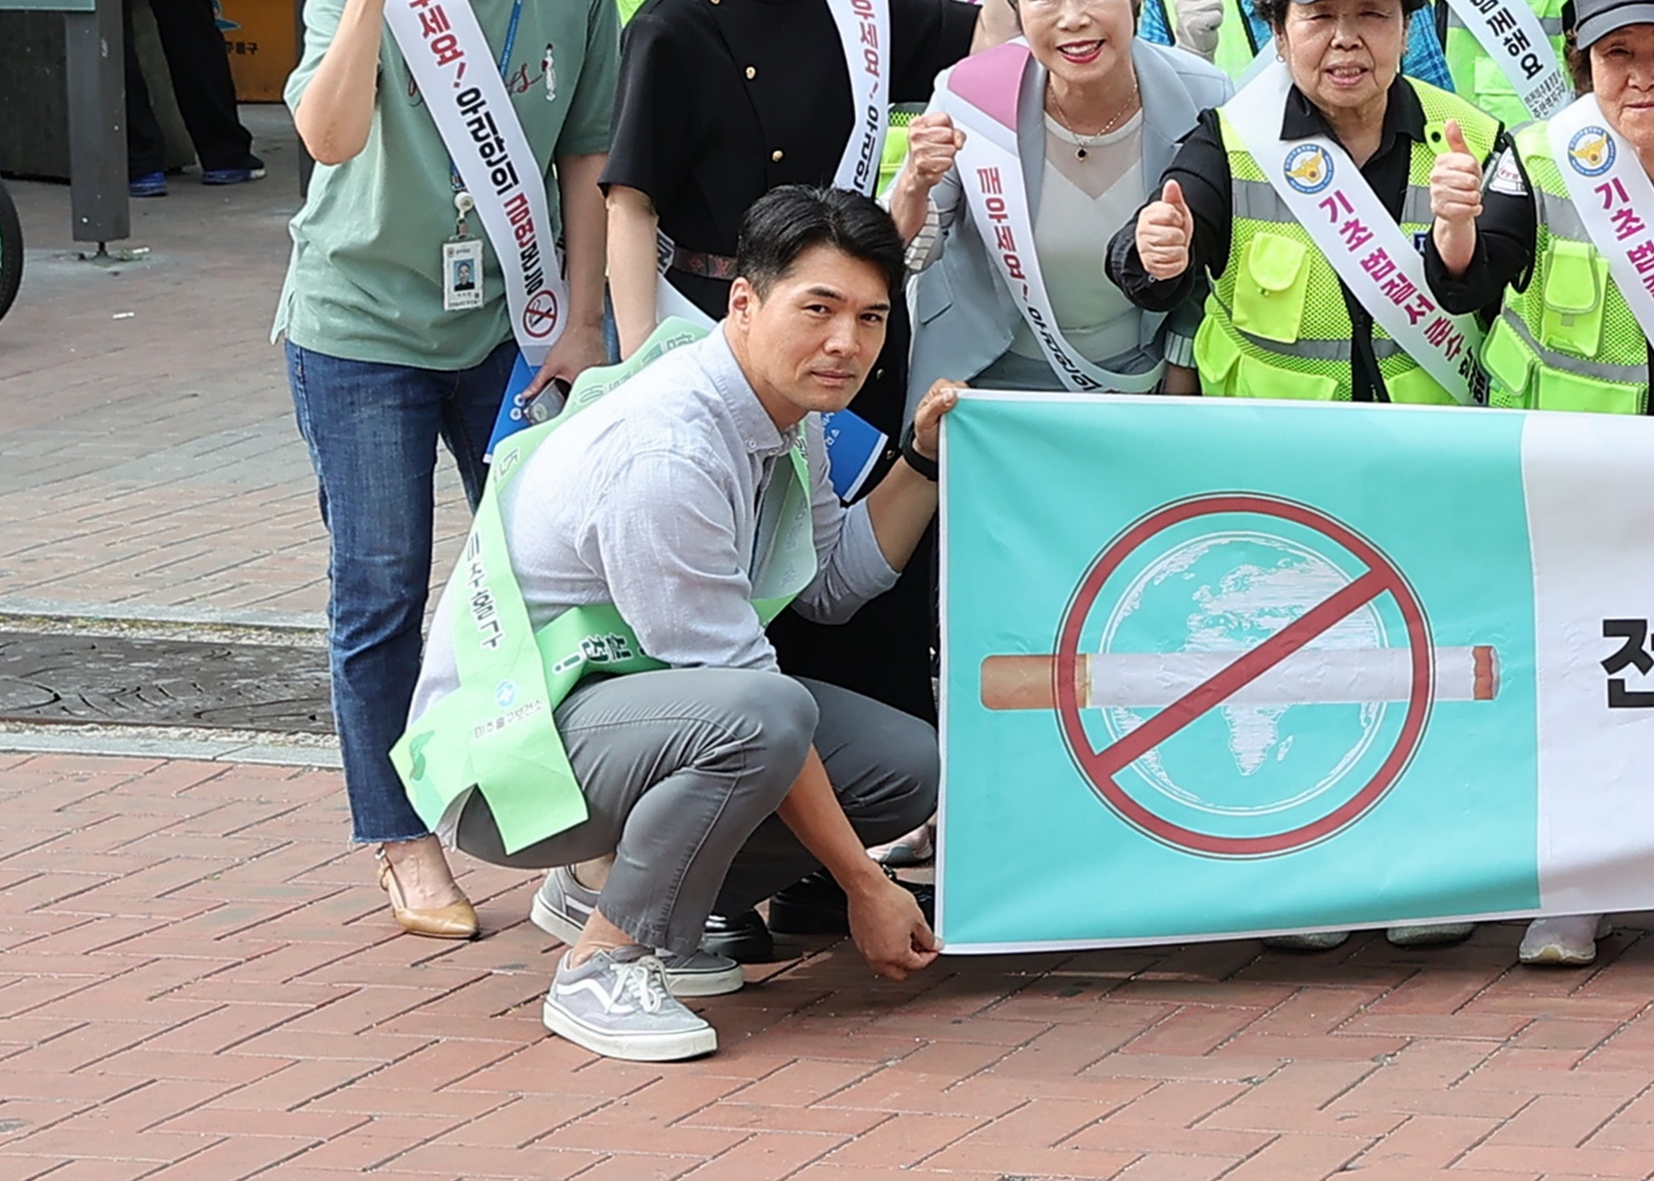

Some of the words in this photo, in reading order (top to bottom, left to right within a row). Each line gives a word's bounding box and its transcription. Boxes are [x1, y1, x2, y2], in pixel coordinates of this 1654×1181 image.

[976, 166, 1030, 304] 깨우세요!
[1593, 179, 1646, 244] 기초
[1317, 189, 1375, 254] 기초
[1358, 244, 1436, 326] 법질서
[1424, 312, 1469, 362] 준수
[465, 530, 504, 651] 미추홀구
[473, 697, 545, 740] 미추홀구보건소
